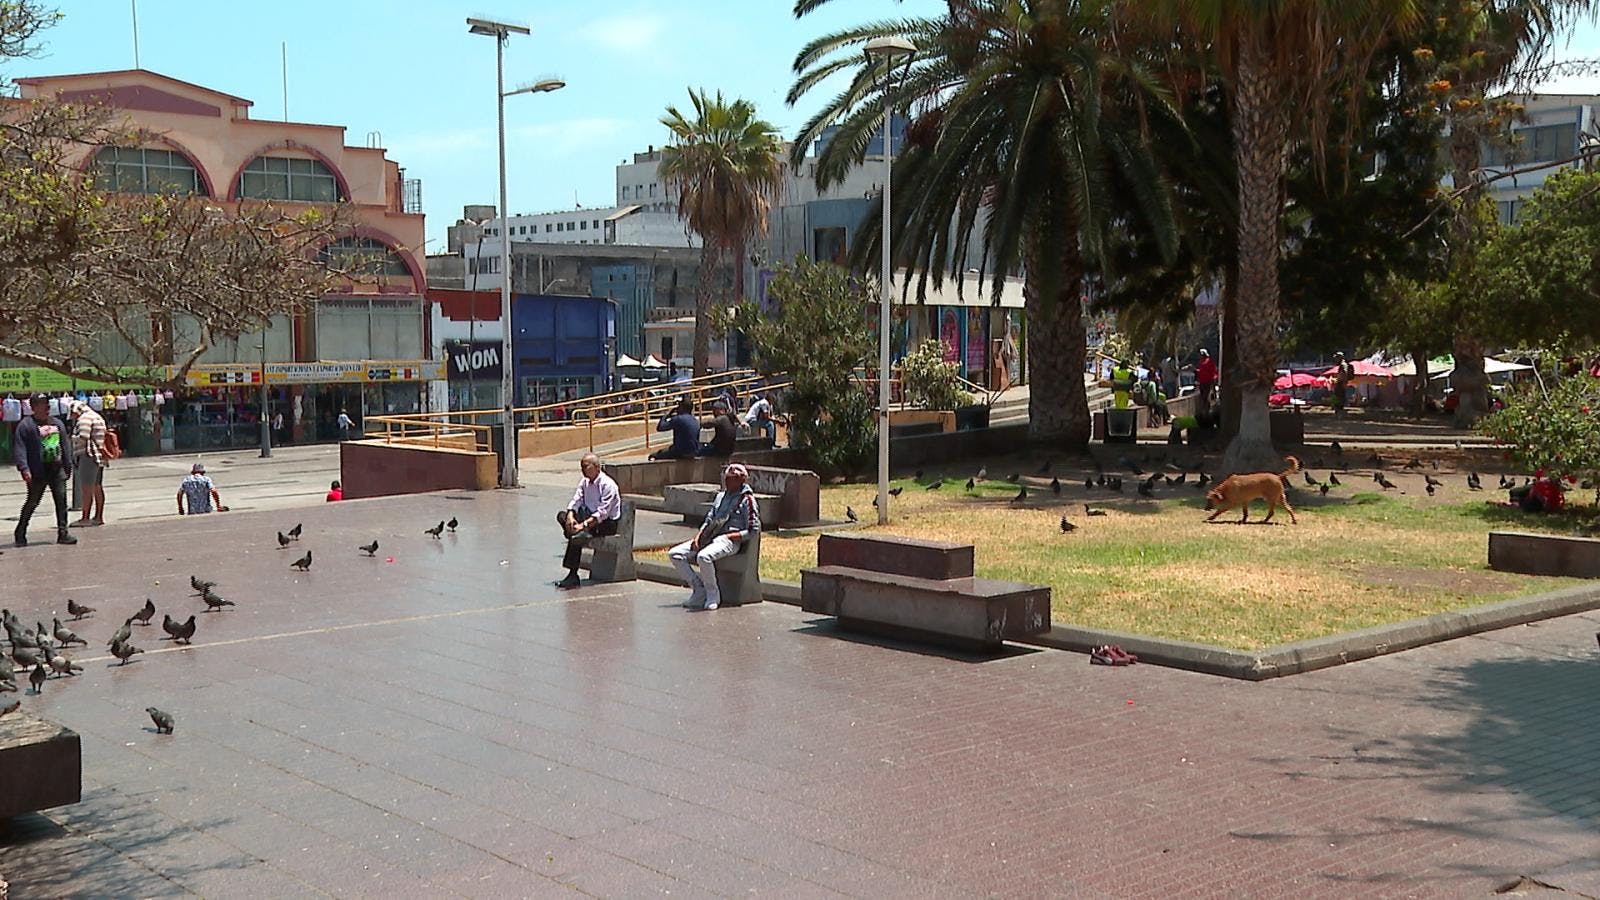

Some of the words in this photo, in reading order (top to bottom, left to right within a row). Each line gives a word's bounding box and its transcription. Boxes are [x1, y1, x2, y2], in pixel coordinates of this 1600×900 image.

[454, 347, 500, 373] WOM
[1, 372, 20, 380] Gato
[0, 380, 19, 388] egro
